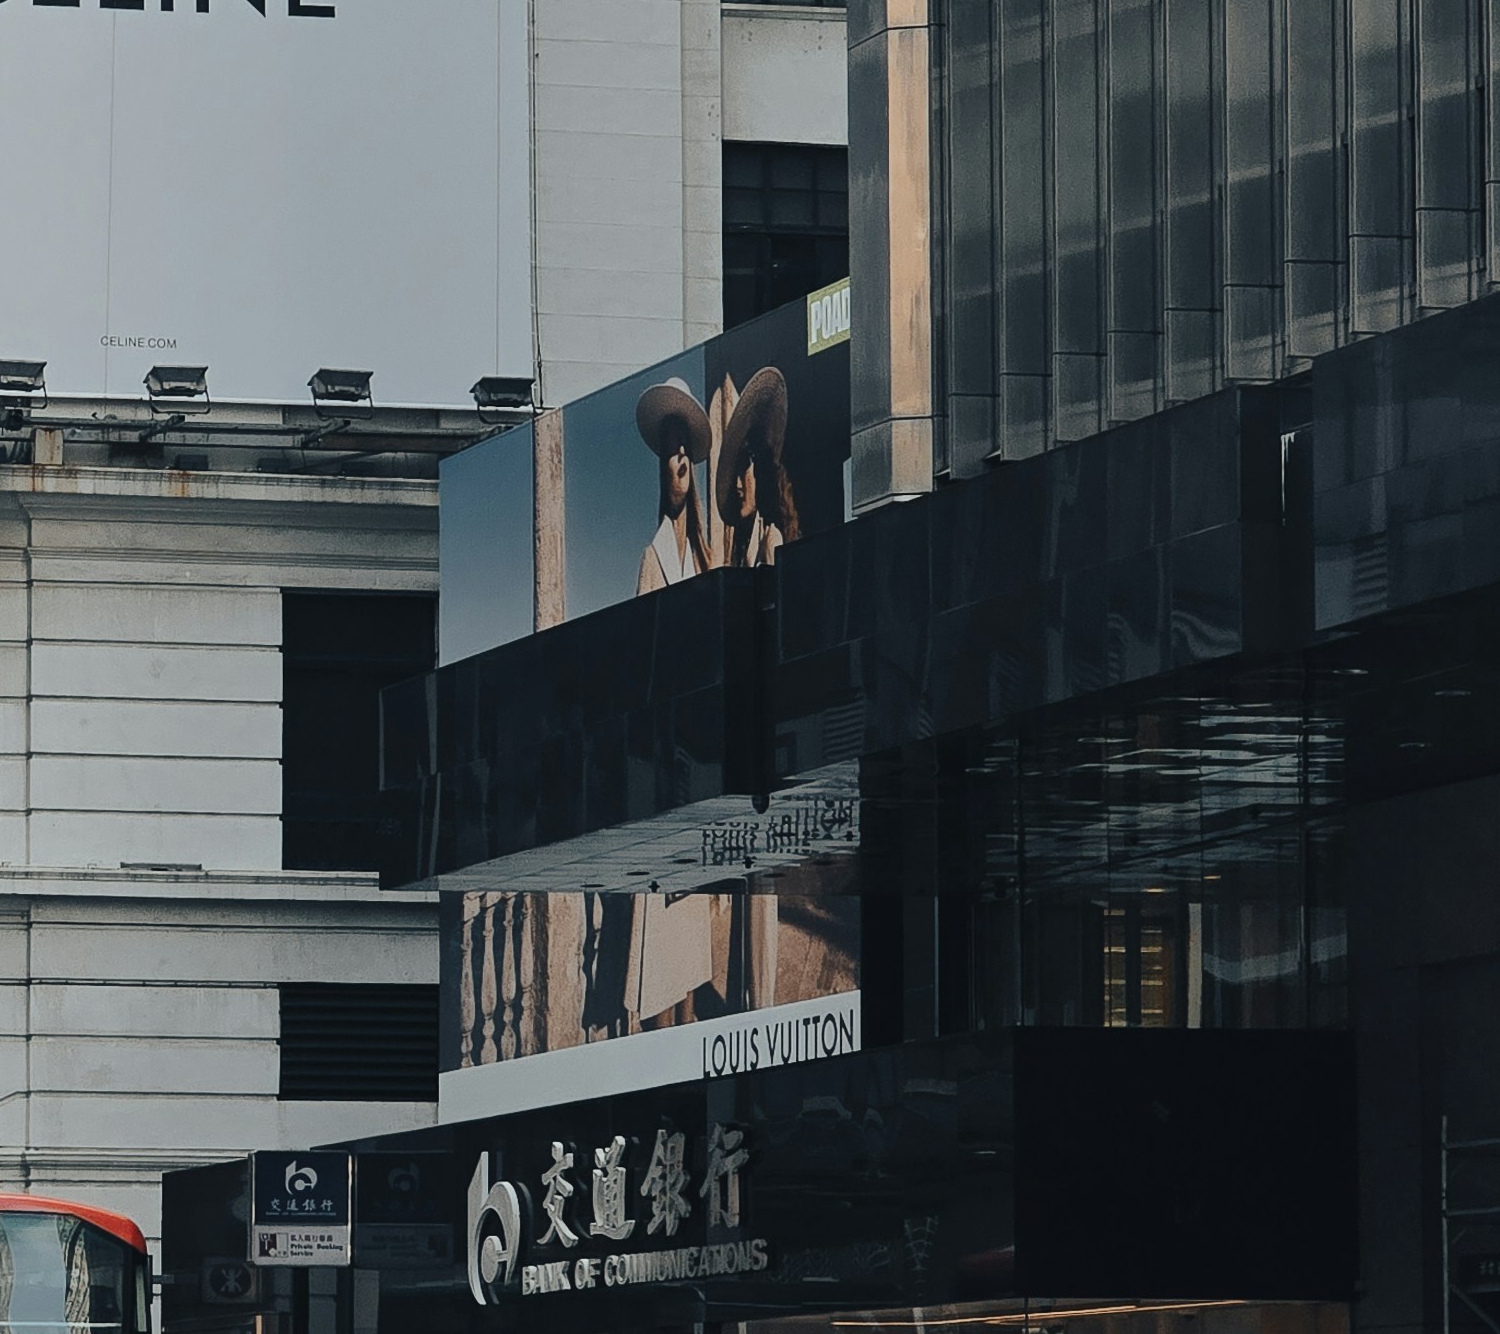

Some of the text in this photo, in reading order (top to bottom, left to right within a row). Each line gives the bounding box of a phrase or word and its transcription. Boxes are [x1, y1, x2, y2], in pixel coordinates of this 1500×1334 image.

[100, 335, 177, 350] CELINE.COM
[810, 287, 850, 344] POAD
[703, 1009, 854, 1079] LOUIS VUITTON
[536, 1123, 750, 1248] 交通銀行
[522, 1238, 768, 1295] BANK OF COMMUNICATIONS
